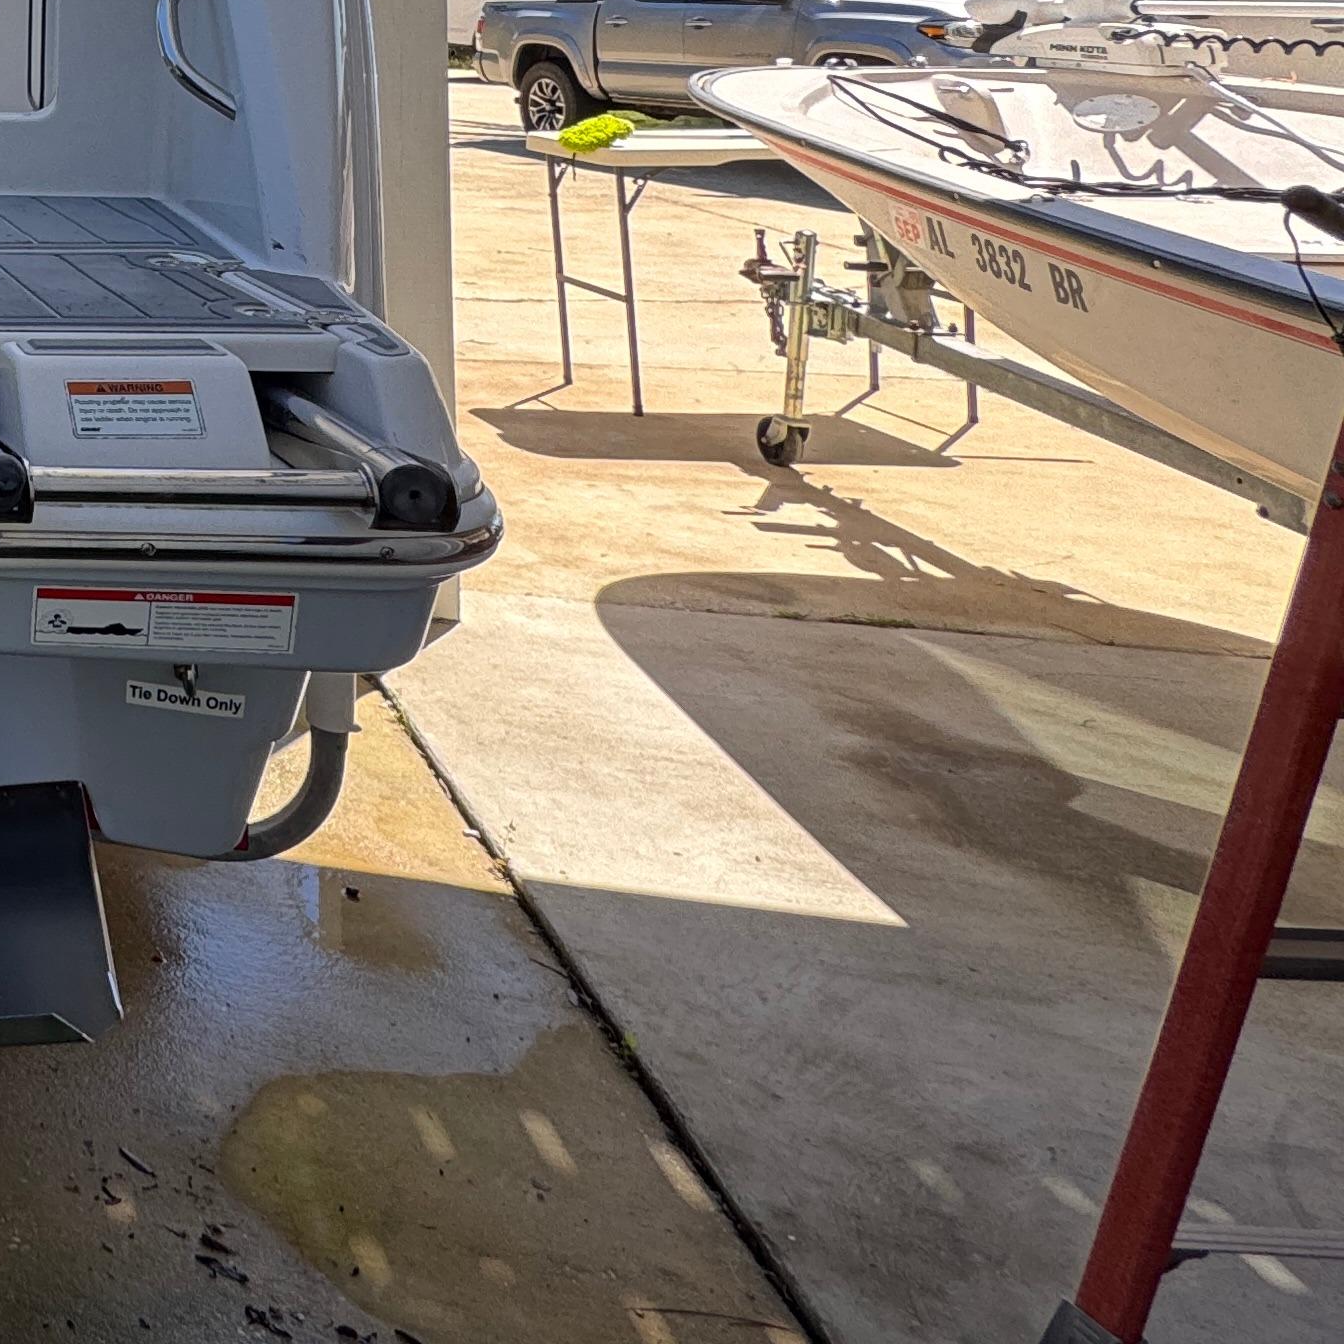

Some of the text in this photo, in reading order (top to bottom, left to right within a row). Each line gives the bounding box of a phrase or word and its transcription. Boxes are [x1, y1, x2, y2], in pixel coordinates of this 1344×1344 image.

[926, 216, 1089, 313] AL 3832 BR
[107, 383, 164, 393] WARNING
[145, 593, 194, 602] DANGER
[129, 684, 242, 715] Tie Down Only
